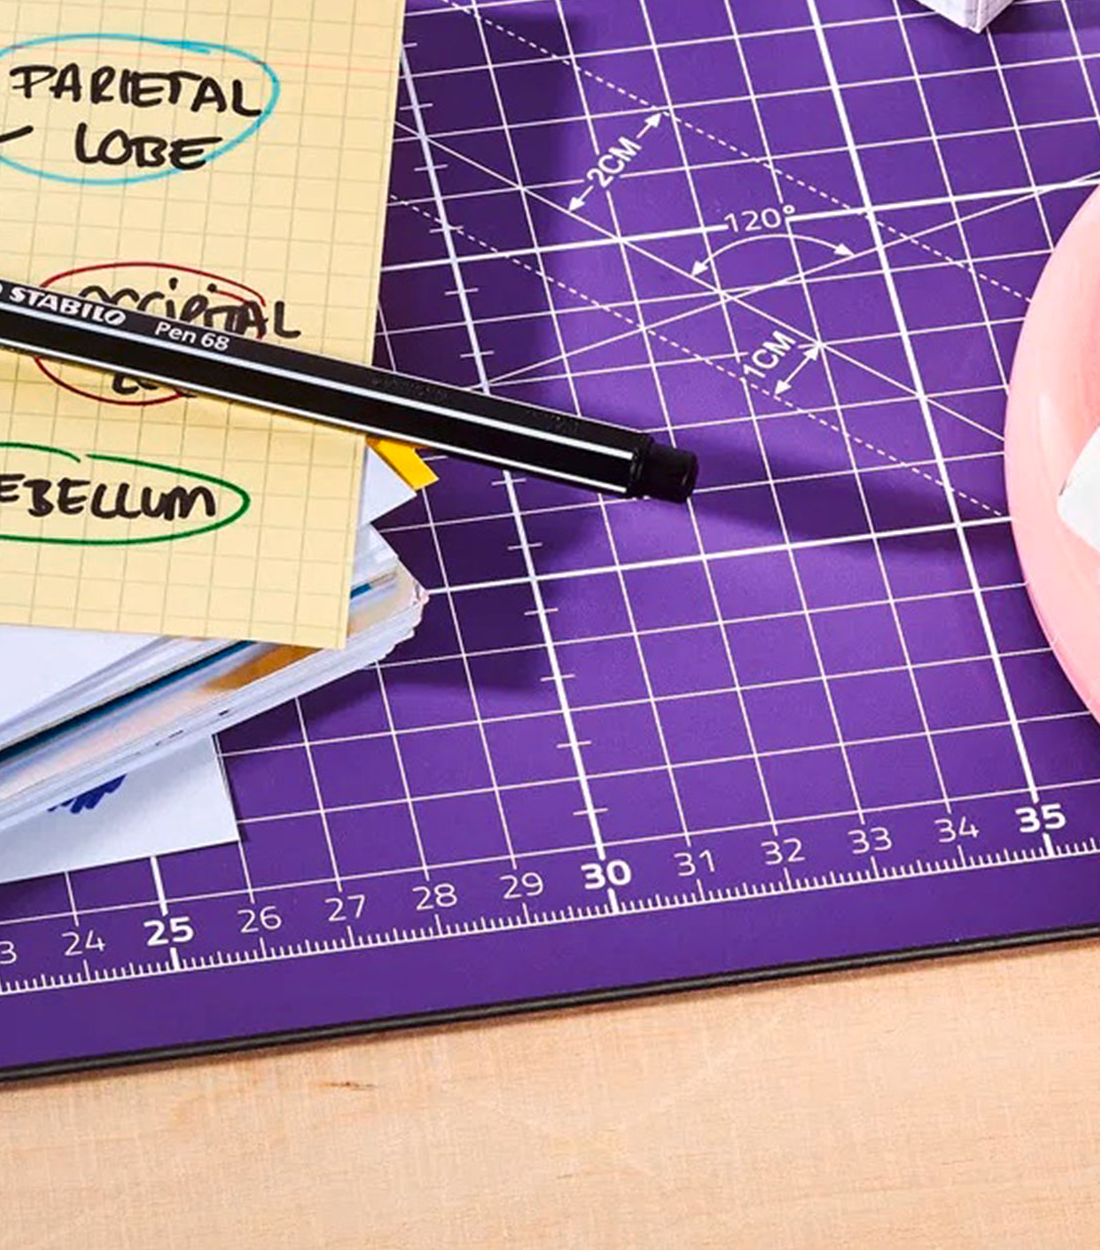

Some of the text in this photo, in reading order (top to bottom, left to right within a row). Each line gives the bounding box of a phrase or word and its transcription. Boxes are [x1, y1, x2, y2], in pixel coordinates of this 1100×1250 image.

[8, 62, 263, 119] PARIETAL
[74, 122, 224, 171] LOBE
[587, 134, 643, 189] 2CM
[724, 203, 797, 234] 120°
[8, 286, 231, 353] STABILO Pen 68
[742, 329, 798, 382] 1CM
[61, 929, 107, 956] 24
[142, 915, 195, 947] 25
[238, 905, 283, 934] 26
[324, 894, 368, 922] 27
[412, 882, 458, 911] 28
[499, 871, 544, 900] 29
[580, 858, 633, 890] 30
[673, 849, 716, 877] 31
[760, 838, 806, 866] 32
[847, 827, 894, 854] 33
[933, 815, 981, 844] 34
[1014, 802, 1068, 835] 35
